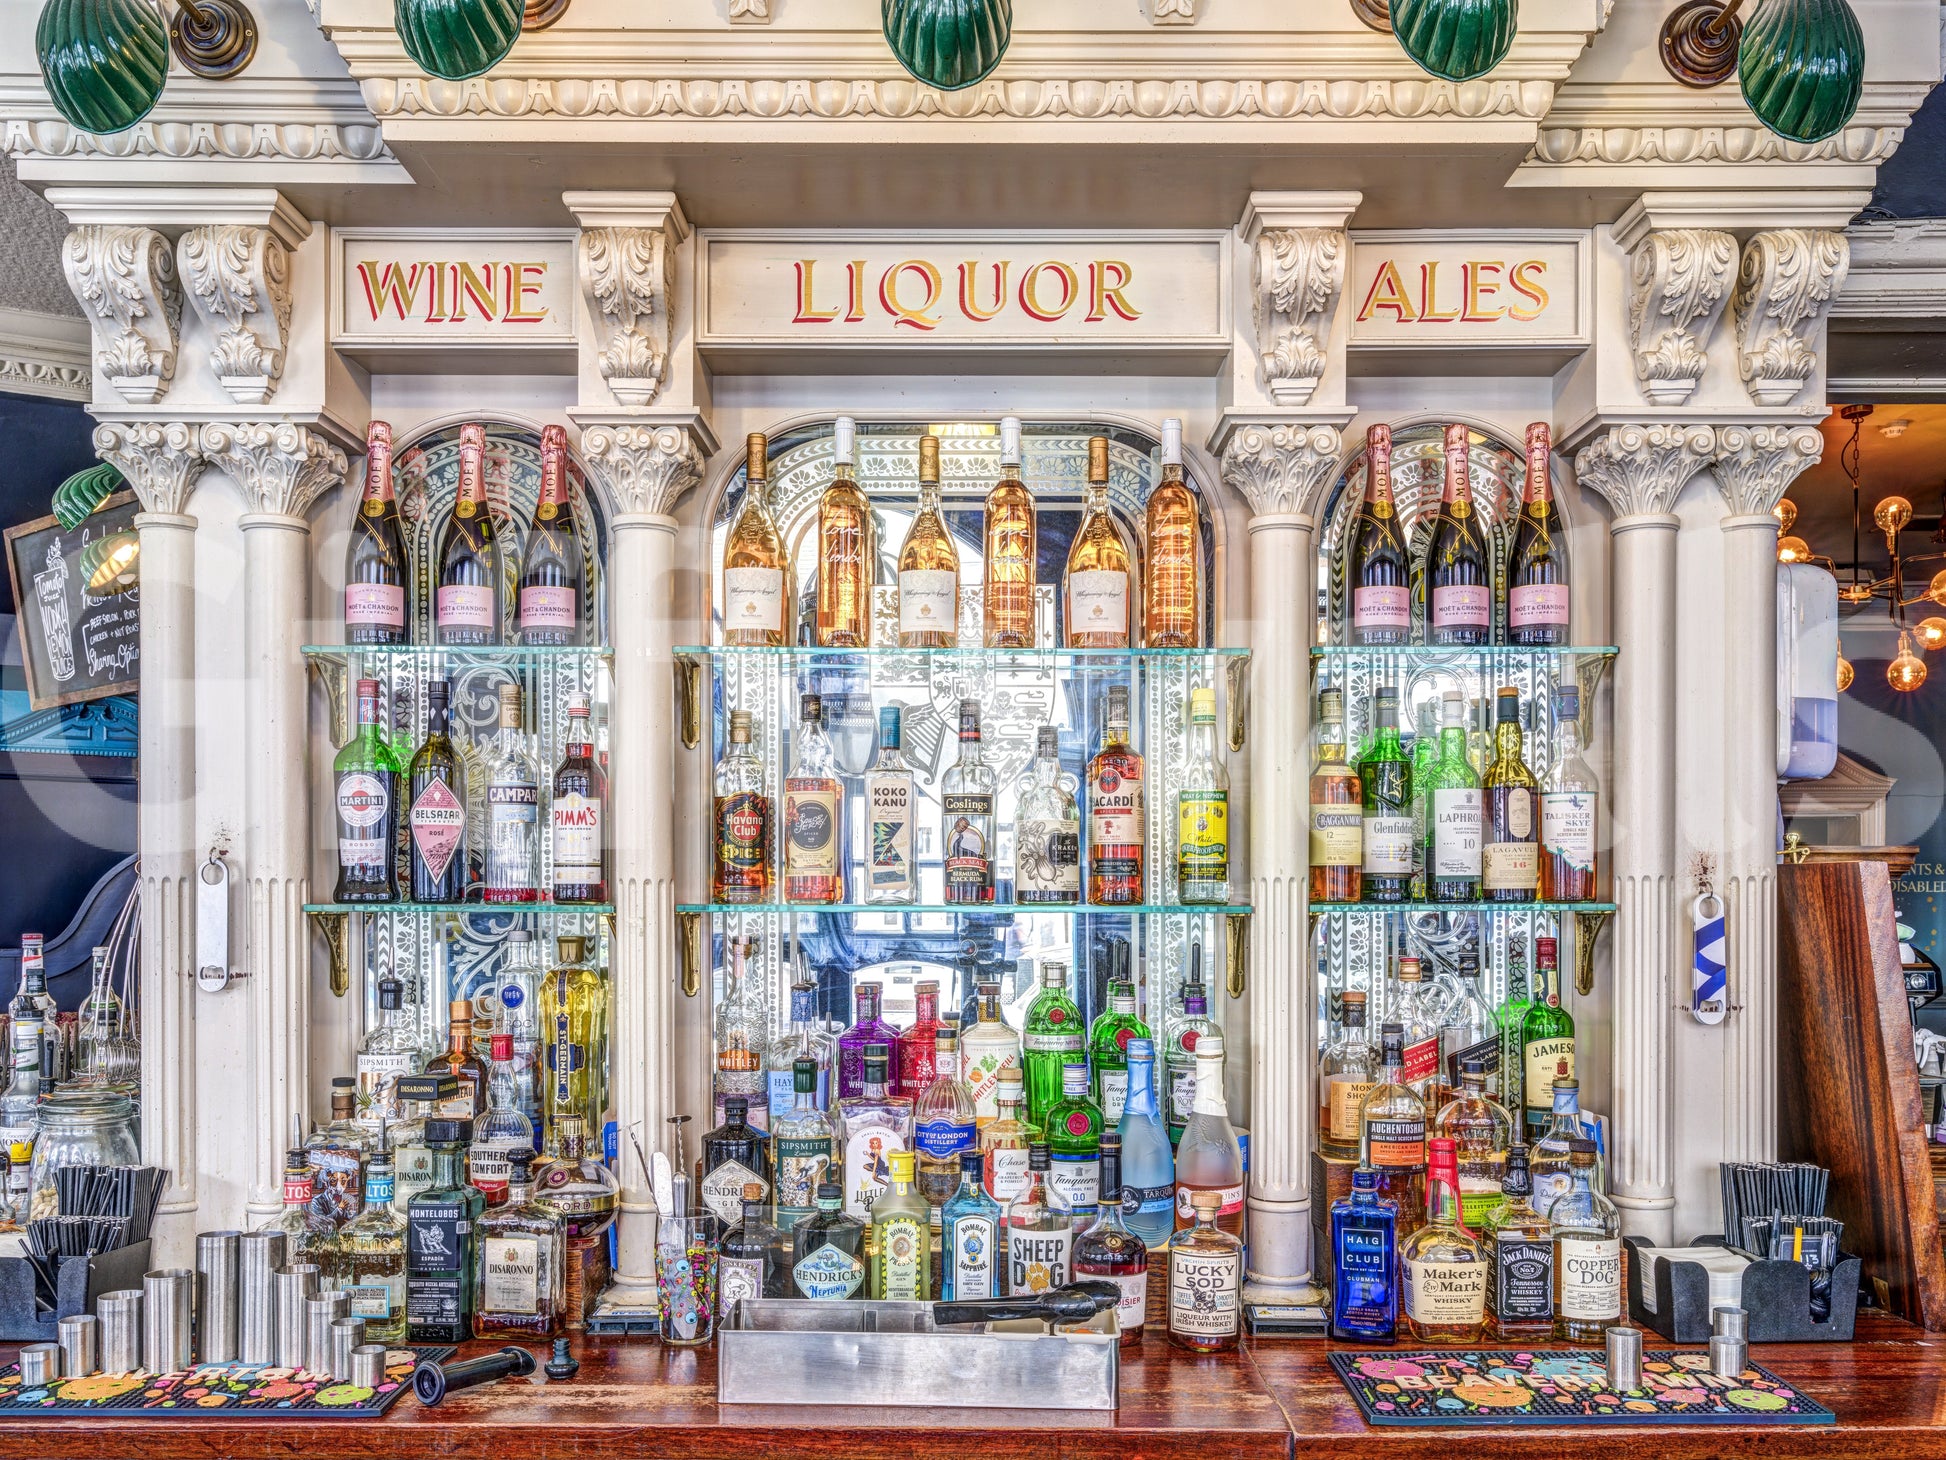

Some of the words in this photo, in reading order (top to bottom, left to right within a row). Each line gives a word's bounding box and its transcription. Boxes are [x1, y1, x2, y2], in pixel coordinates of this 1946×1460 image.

[357, 260, 549, 323] WINE
[792, 259, 1143, 331] LIQUOR
[1356, 259, 1550, 323] ALES
[36, 574, 62, 598] Tomato
[367, 603, 399, 612] CHANDON
[456, 605, 488, 613] CHANDON
[540, 605, 571, 614] CHANDON
[88, 647, 117, 681] Sharing
[490, 787, 538, 803] CAMPAR
[874, 787, 908, 797] KOKO
[341, 796, 383, 806] MARTINI
[874, 797, 908, 807] KANU
[945, 799, 988, 813] Goslings
[415, 809, 460, 820] BELSAZAR
[554, 806, 598, 826] PIMM'S
[726, 813, 763, 826] Havana
[1544, 812, 1591, 821] TALISKER
[1565, 819, 1591, 827] SKYE
[429, 828, 445, 837] ROSÉ
[733, 824, 758, 837] Club
[1326, 831, 1334, 839] 12
[1463, 838, 1475, 850] 10
[1512, 861, 1527, 869] 16
[1934, 864, 1945, 876] &
[360, 1058, 404, 1066] SIPSMITH
[559, 1029, 567, 1086] ST-GERMAIN
[719, 1057, 759, 1068] WHITLEY
[902, 1079, 931, 1087] WHITLEY
[400, 1085, 434, 1094] DISARONNO
[1371, 1122, 1424, 1135] AUCHENTOSHAN
[917, 1131, 931, 1139] CITY
[780, 1140, 828, 1150] SIPSMITH
[924, 1138, 959, 1146] DISTILLERY
[310, 1151, 359, 1169] BALLER
[471, 1151, 508, 1163] SOUTHER
[998, 1153, 1027, 1169] Chase
[472, 1162, 510, 1175] COMFORT
[284, 1185, 311, 1199] LTOS
[366, 1184, 394, 1198] LTOS
[1072, 1192, 1086, 1202] 0.0
[410, 1208, 459, 1218] MONTELOBOS
[889, 1226, 915, 1240] BOMBAY
[960, 1223, 988, 1235] BOMBAY
[1346, 1235, 1380, 1246] HAIG
[1013, 1237, 1064, 1262] SHEEP
[1346, 1255, 1381, 1265] CLUB
[1502, 1250, 1523, 1266] JACK
[489, 1263, 535, 1276] DISARONNO
[958, 1260, 989, 1272] SAPPHIRE
[1176, 1262, 1235, 1276] LUCKY
[1567, 1258, 1619, 1273] COPPER
[796, 1269, 864, 1283] HENDRICK'S
[1346, 1275, 1381, 1283] CLUBMAN
[1423, 1268, 1483, 1280] Maker's
[1581, 1271, 1614, 1284] DOG
[1186, 1276, 1225, 1289] SOD
[1440, 1281, 1482, 1292] Mark
[1510, 1278, 1544, 1287] Tennessee
[1175, 1318, 1195, 1326] IRISH
[1176, 1311, 1211, 1322] LIQUEUR
